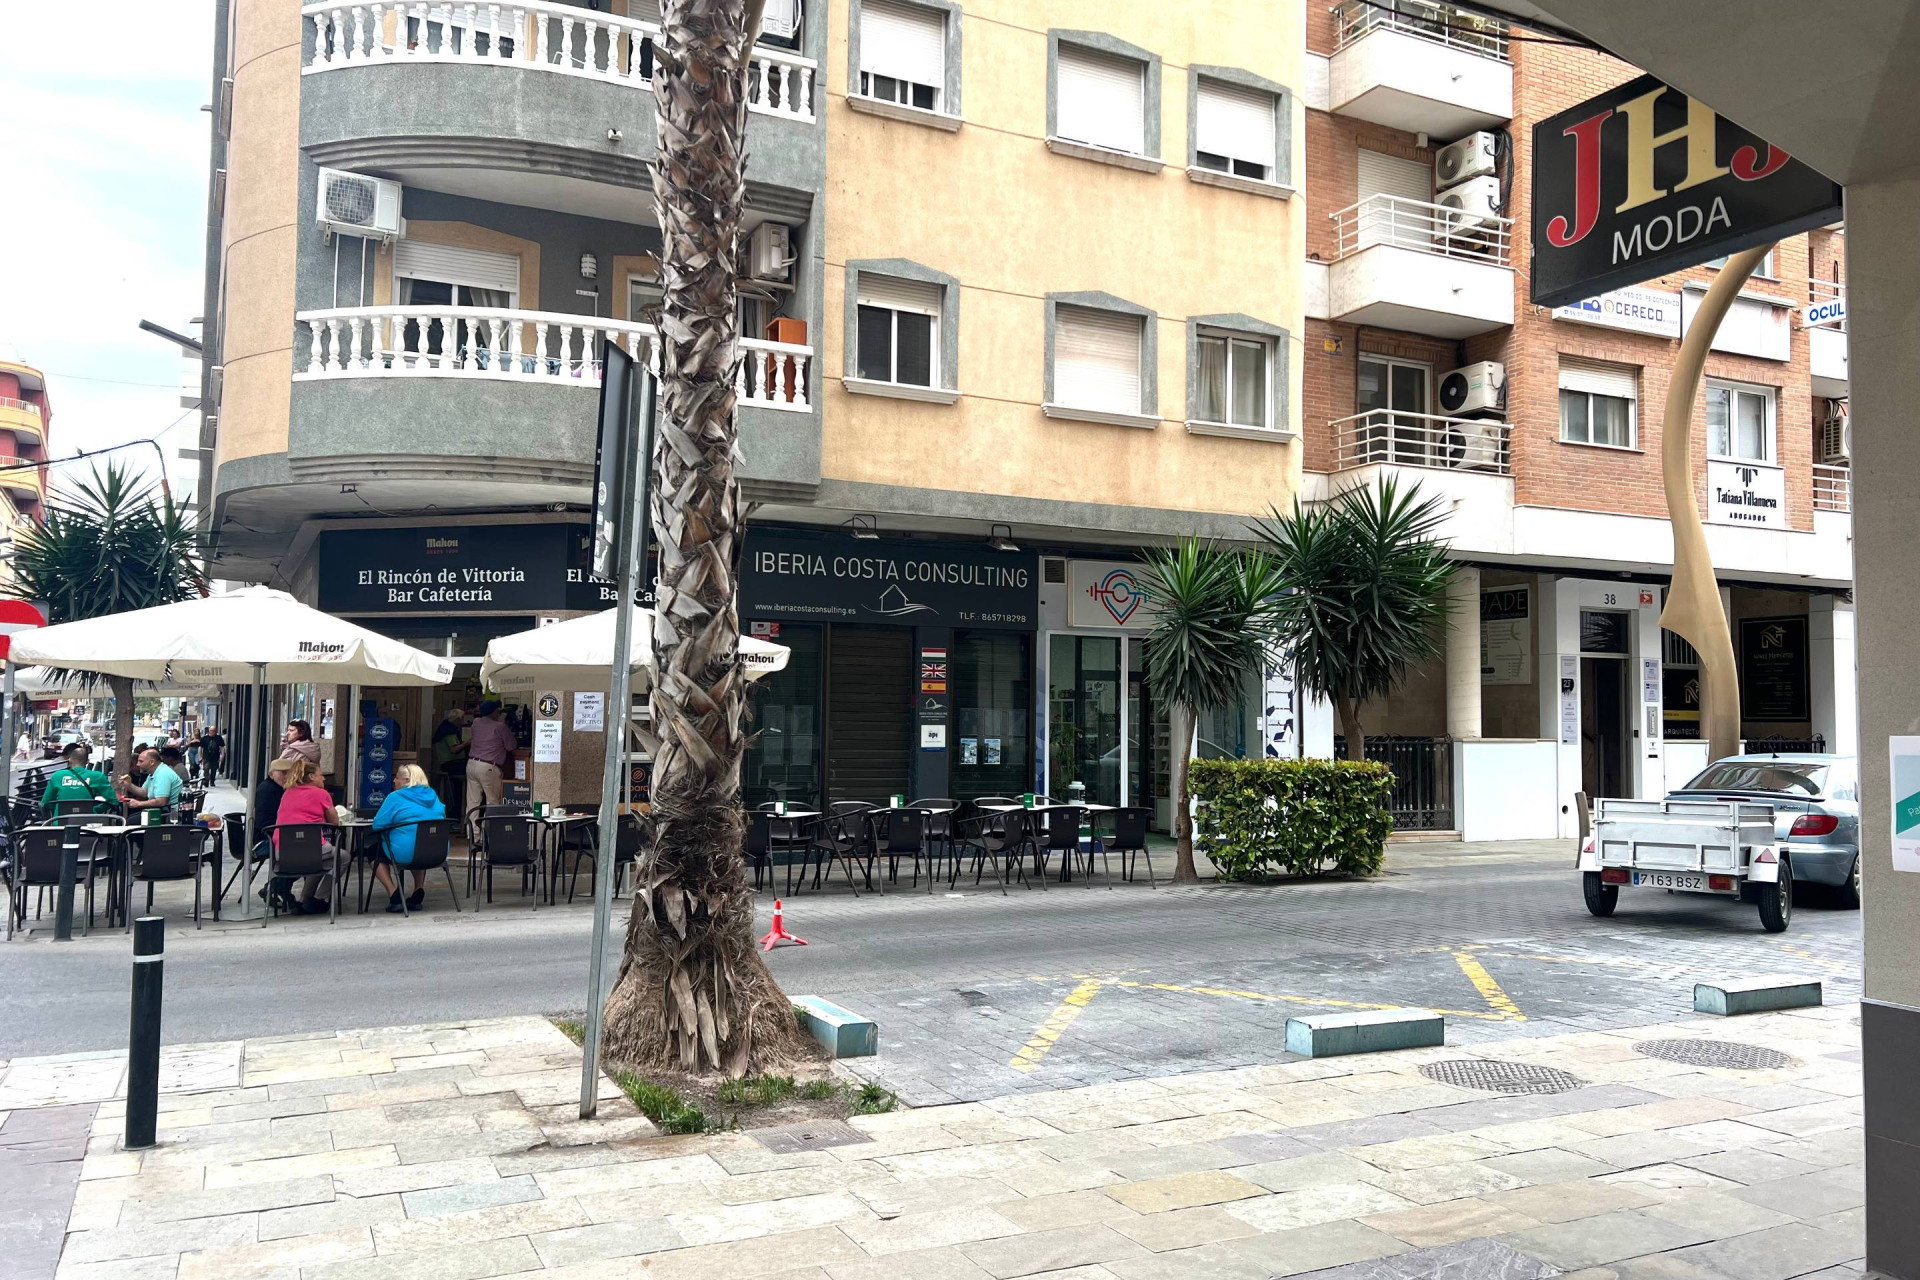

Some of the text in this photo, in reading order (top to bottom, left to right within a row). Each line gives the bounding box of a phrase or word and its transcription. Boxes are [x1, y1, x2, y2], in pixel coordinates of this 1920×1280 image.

[1611, 196, 1732, 265] MODA
[1809, 302, 1845, 322] OCUL
[1716, 487, 1777, 508] Tatiana Villanueva
[426, 538, 459, 548] Mahou
[358, 567, 525, 585] El Rincón de Vittoria
[566, 568, 583, 582] El
[754, 551, 1028, 588] IBERIA COSTA CONSULTING
[387, 586, 493, 603] Bar Cafetería
[599, 587, 619, 601] Ba
[1603, 593, 1616, 605] 38
[754, 603, 857, 617] www.iberiacostaconsulting.es
[981, 613, 1027, 623] 865718298
[1640, 873, 1702, 889] 7163 BSZ
